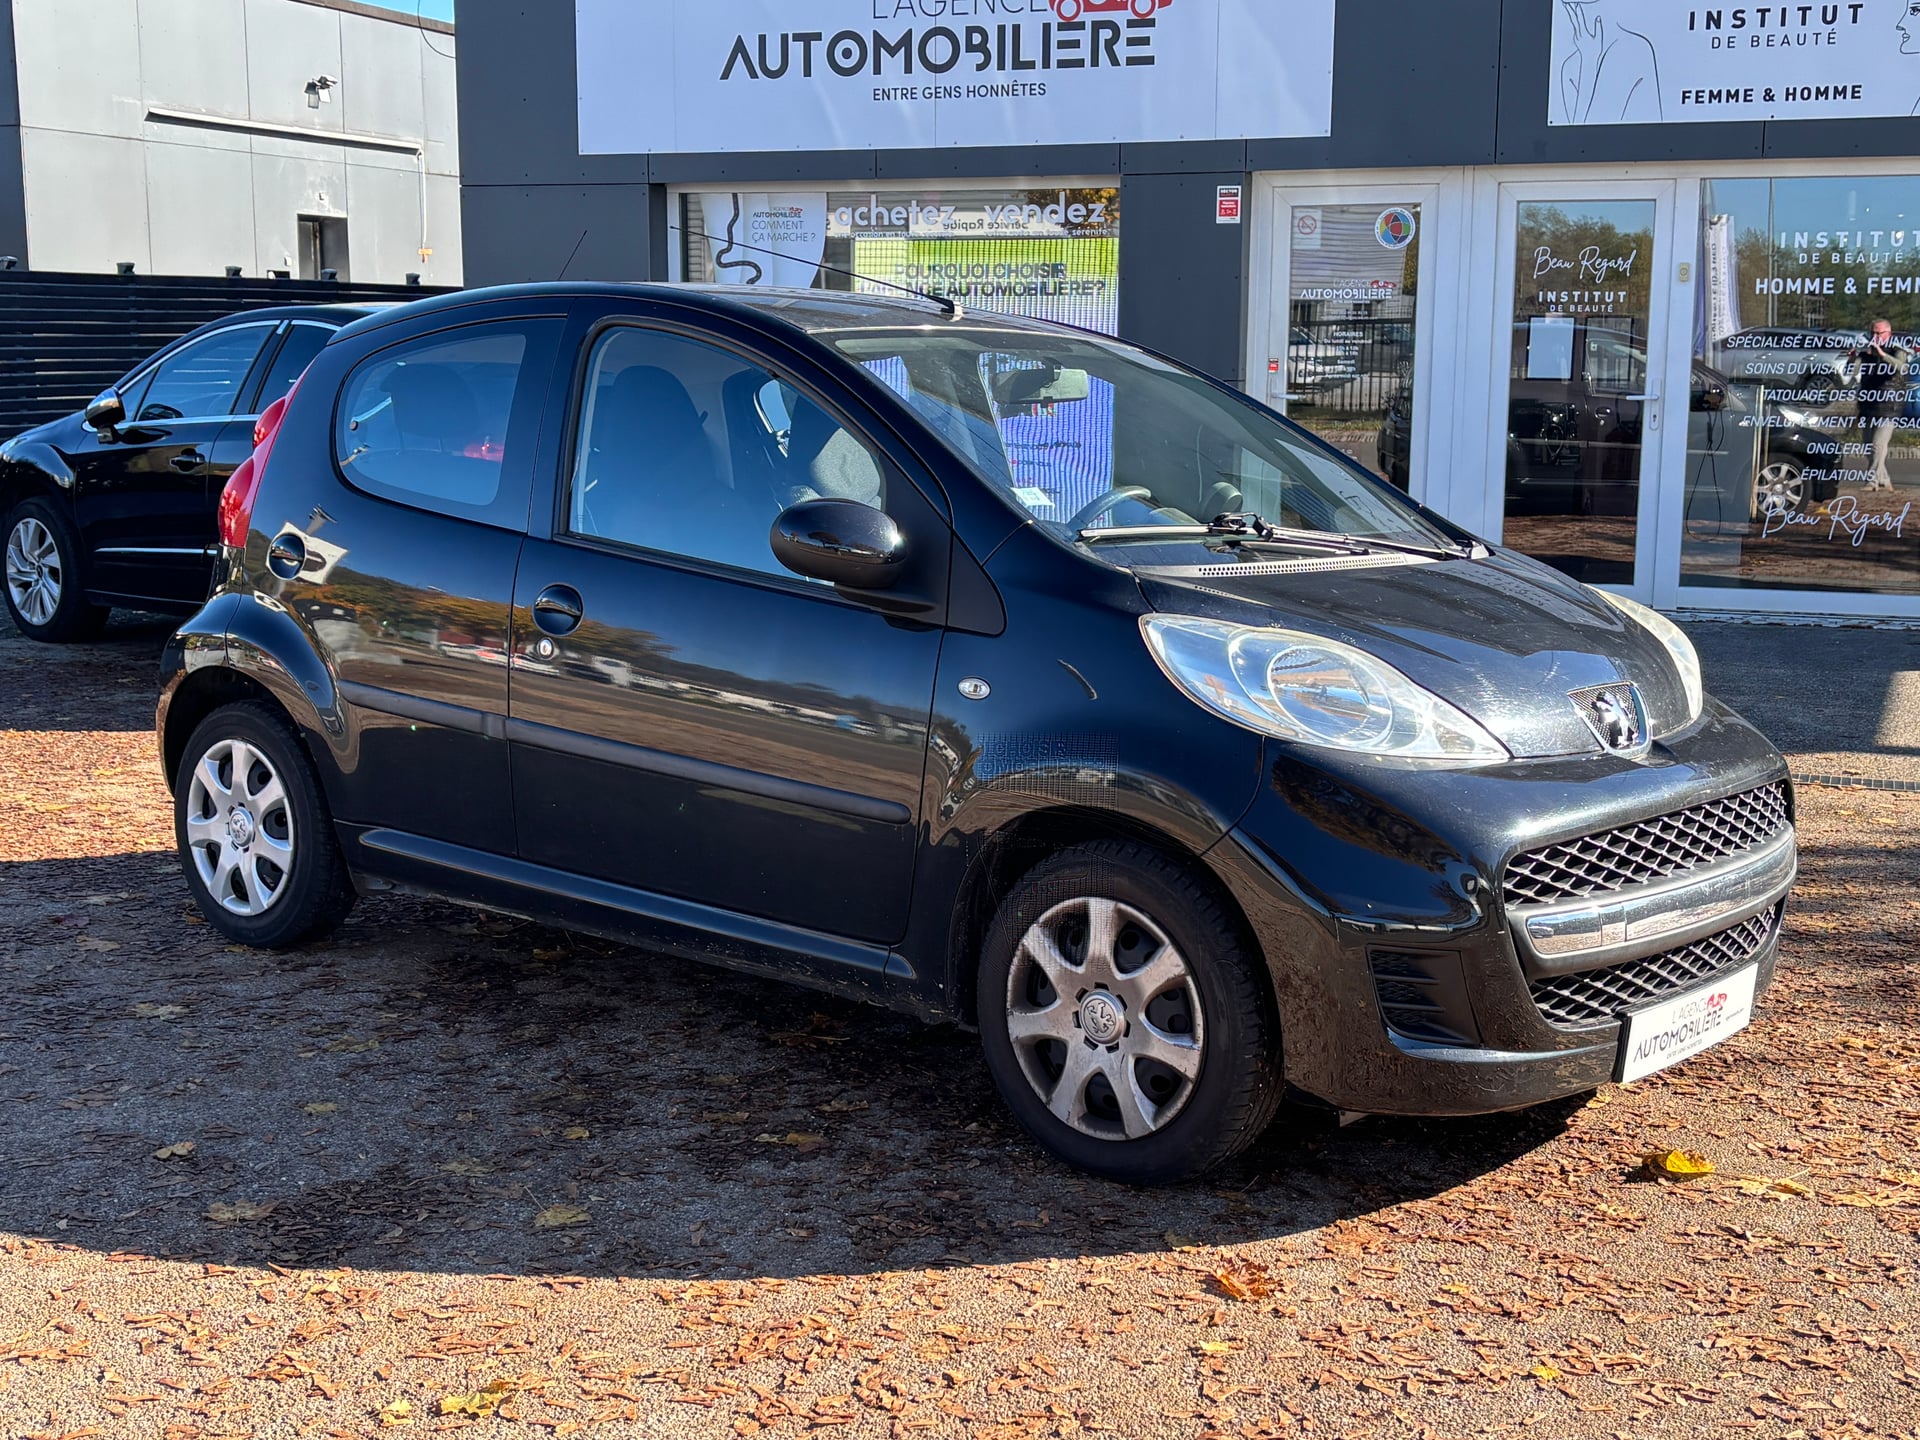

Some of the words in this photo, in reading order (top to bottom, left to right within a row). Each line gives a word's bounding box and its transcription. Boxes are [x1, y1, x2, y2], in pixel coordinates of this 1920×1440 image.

[1688, 2, 1864, 31] INSTITUT
[1711, 35, 1737, 49] DE
[1750, 28, 1838, 48] BEAUTÉ
[872, 86, 918, 101] ENTRE
[922, 85, 963, 99] GENS
[966, 80, 1047, 98] HONNÊTES
[1681, 87, 1755, 105] FEMME
[1762, 87, 1776, 103] &
[1784, 84, 1863, 102] HOMME
[834, 194, 957, 226] achetez
[983, 191, 1106, 224] vendez
[751, 220, 805, 230] COMMENT
[751, 232, 765, 243] ÇA
[767, 232, 809, 242] MARCHE
[811, 232, 816, 242] ?
[1780, 230, 1920, 249] INSTITUT
[1533, 246, 1575, 280] Beau
[1578, 245, 1637, 284] Regard
[1799, 252, 1821, 264] DE
[1831, 249, 1904, 264] BEAUTÉ
[1755, 277, 1836, 295] HOMME
[1843, 276, 1857, 295] &
[1538, 290, 1627, 302] INSTITUT
[1549, 304, 1564, 312] DE
[1569, 303, 1614, 313] BEAUTÉ
[1726, 334, 1803, 348] SPÉCIALISÉ
[1804, 335, 1824, 348] EN
[1825, 335, 1866, 348] SOINS
[1744, 362, 1785, 375] SOINS
[1787, 362, 1808, 375] DU
[1858, 363, 1877, 375] ET
[1877, 363, 1898, 375] DU
[1899, 363, 1920, 376] CO
[1763, 389, 1829, 401] TATOUAGE
[1829, 389, 1857, 402] DES
[1857, 416, 1867, 429] &
[1806, 442, 1875, 455] ONGLERIE
[1800, 466, 1877, 482] ÉPILATIONS
[1762, 495, 1821, 539] Beau
[1827, 495, 1911, 547] Regard
